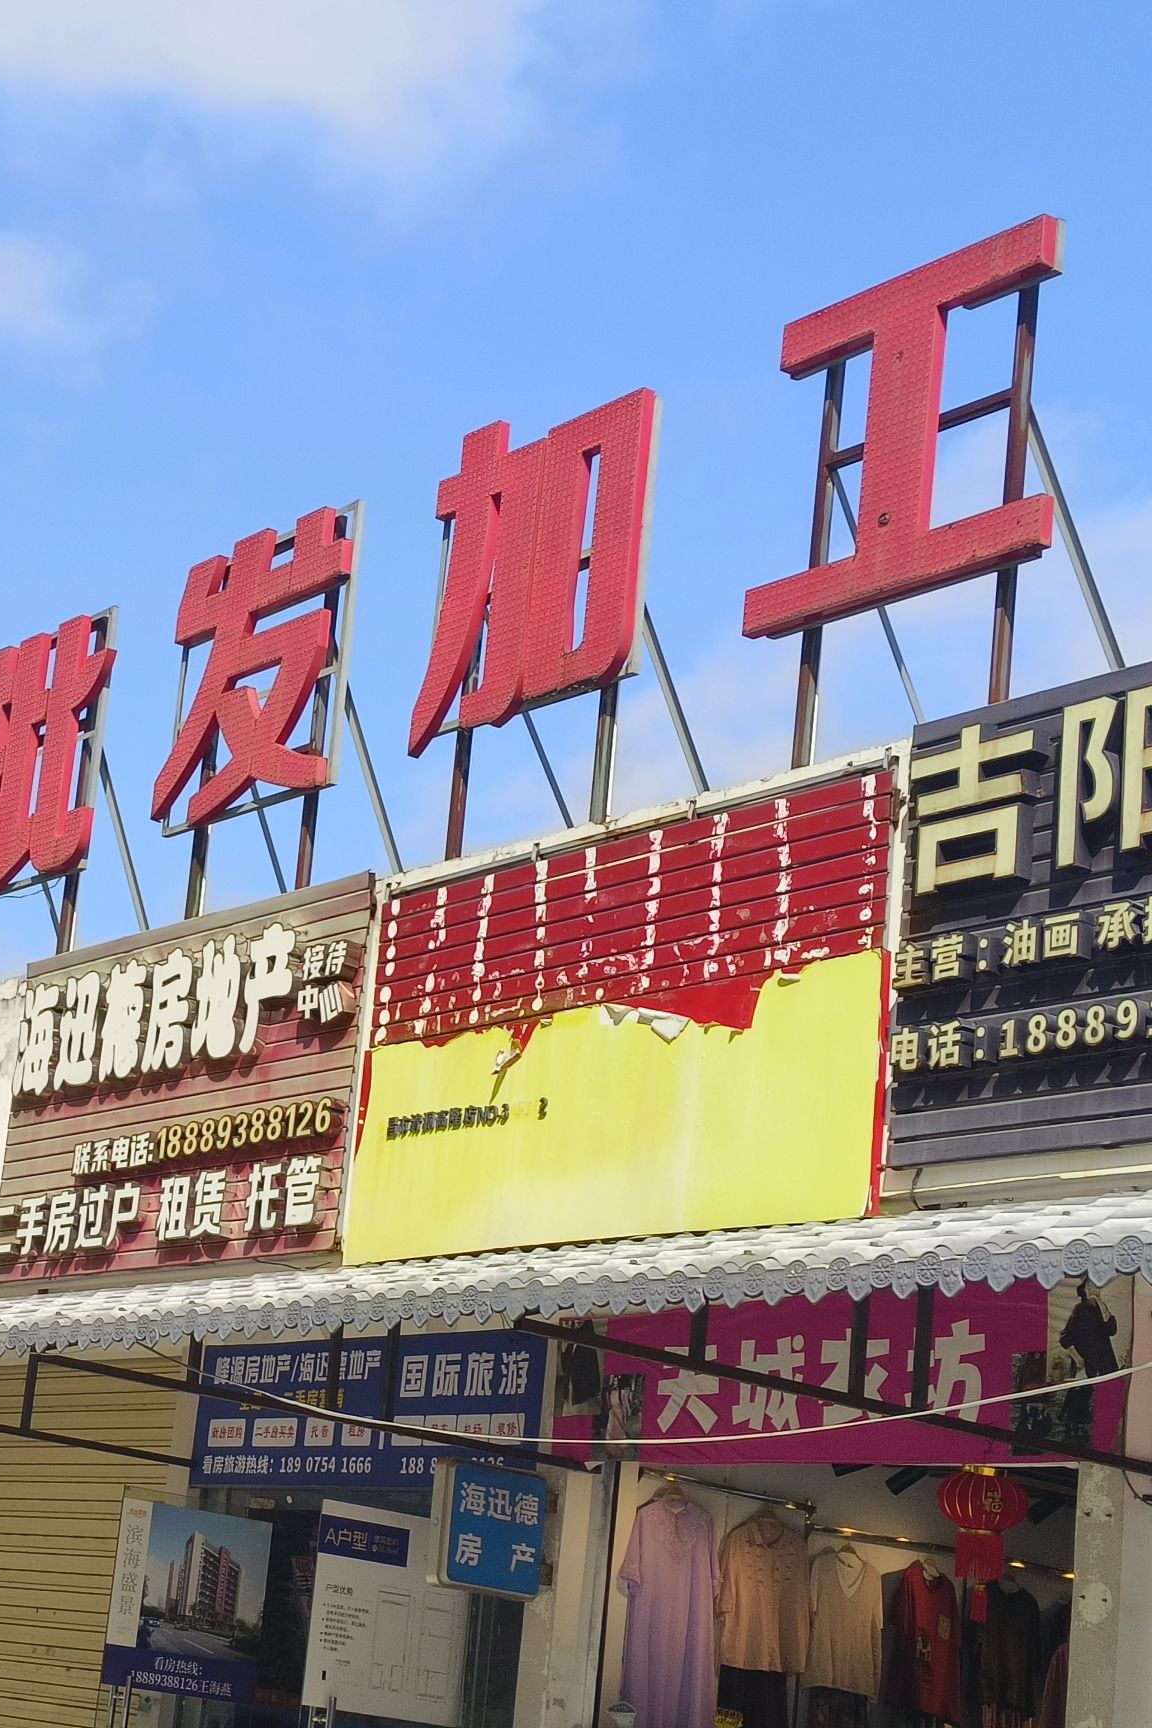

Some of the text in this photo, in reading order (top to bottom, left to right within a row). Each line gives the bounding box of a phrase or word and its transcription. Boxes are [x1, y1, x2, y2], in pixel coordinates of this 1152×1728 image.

[303, 940, 348, 980] 接待
[297, 984, 346, 1025] 中心
[156, 1169, 228, 1242] 租赁
[244, 1155, 324, 1233] 托管
[400, 1351, 530, 1397] 国际旅游
[280, 1457, 300, 1473] 189
[306, 1457, 336, 1473] 0754
[340, 1457, 372, 1473] 1666
[400, 1457, 424, 1474] 188
[459, 1481, 539, 1527] 海迅德
[324, 1527, 368, 1552] A户型
[455, 1532, 535, 1574] 房产
[118, 1523, 144, 1616] 滨海盛景
